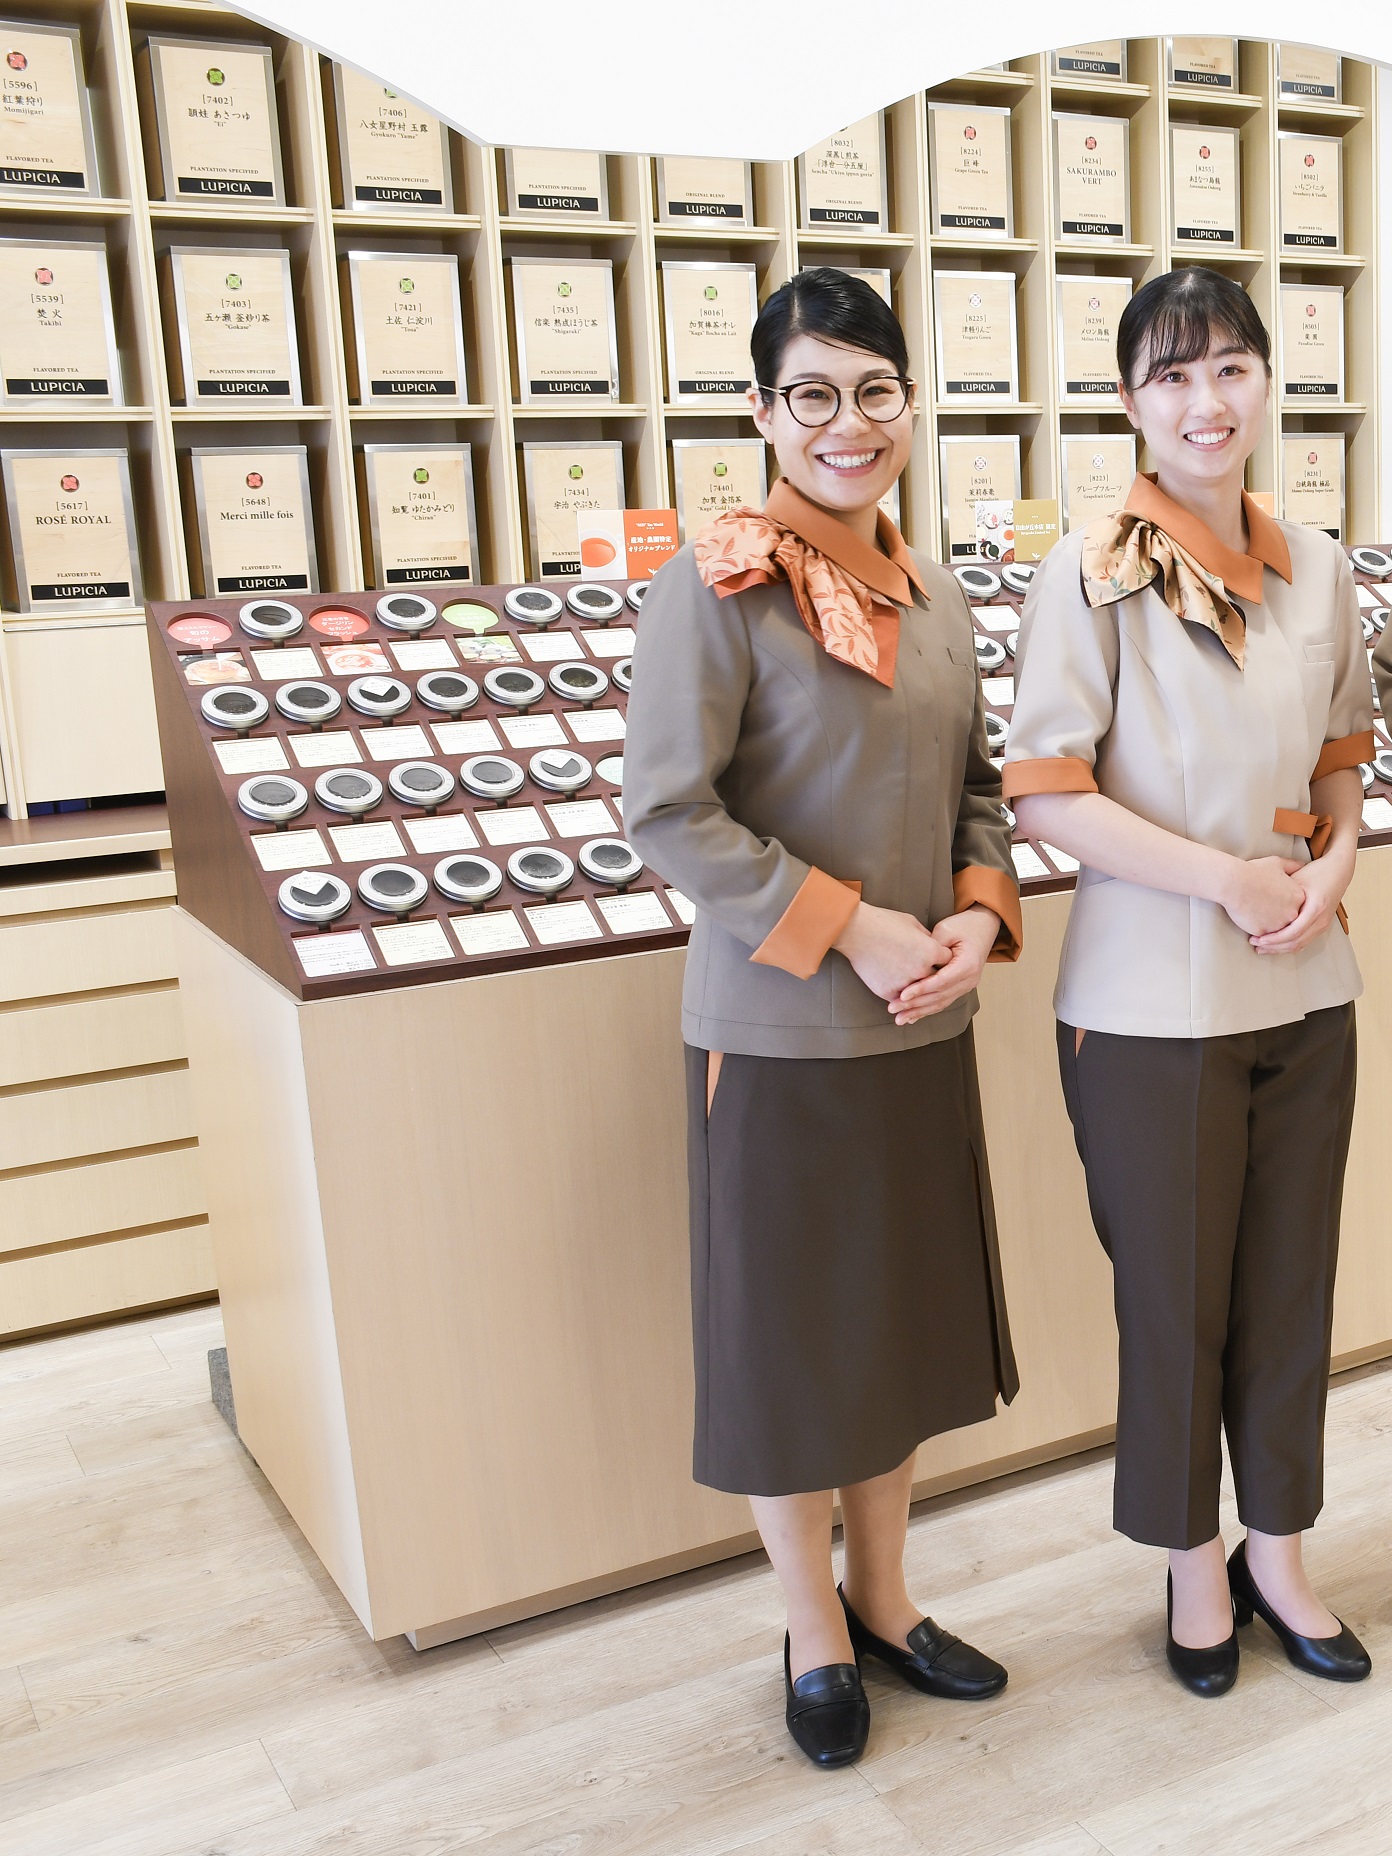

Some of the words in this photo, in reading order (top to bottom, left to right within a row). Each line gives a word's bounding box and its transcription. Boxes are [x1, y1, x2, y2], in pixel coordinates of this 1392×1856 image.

[1073, 62, 1106, 72] LUPICIA
[1188, 74, 1218, 84] LUPICIA
[3, 78, 38, 91] [5596]
[1294, 84, 1322, 94] LUPICIA
[2, 94, 43, 106] 紅葉狩り
[202, 94, 233, 106] [7402]
[4, 106, 44, 116] Momijigari
[213, 109, 250, 121] あさつゆ
[378, 107, 407, 118] [7406]
[360, 120, 406, 132] 八女星野村
[410, 124, 428, 133] 玉露
[831, 138, 853, 148] [8032]
[960, 147, 982, 156] [8224]
[4, 170, 61, 184] LUPICIA
[1066, 167, 1116, 177] SAKURAMBO
[201, 181, 251, 192] LUPICIA
[376, 190, 422, 200] LUPICIA
[538, 198, 580, 208] LUPICIA
[686, 205, 726, 215] LUPICIA
[826, 212, 863, 221] LUPICIA
[956, 218, 990, 226] LUPICIA
[1076, 224, 1110, 234] LUPICIA
[1190, 229, 1222, 240] LUPICIA
[1296, 236, 1325, 245] LUPICIA
[30, 294, 64, 304] [5539]
[221, 299, 251, 308] [7403]
[394, 302, 422, 312] [7421]
[552, 306, 578, 314] [7435]
[700, 308, 724, 318] [8016]
[966, 314, 986, 322] [8225]
[236, 313, 271, 324] 釜炒り茶
[386, 316, 403, 326] 土佐
[534, 318, 550, 328] 信楽
[554, 318, 598, 328] 熟成ほうじ茶
[30, 382, 86, 392] LUPICIA
[219, 383, 270, 394] LUPICIA
[391, 383, 437, 393] LUPICIA
[549, 383, 592, 392] LUPICIA
[696, 383, 735, 392] LUPICIA
[564, 488, 589, 496] [7434]
[710, 484, 733, 492] [7440]
[408, 491, 436, 501] [7401]
[56, 500, 88, 512] [5617]
[242, 496, 270, 507] [5648]
[554, 501, 569, 509] 宇治
[574, 500, 600, 508] やぶきた
[392, 504, 408, 514] 知覧
[412, 504, 455, 514] ゆたかみどり
[36, 514, 68, 526] ROSÉ
[70, 514, 112, 524] ROYAL
[220, 511, 248, 520] Merci
[250, 510, 274, 520] mille
[276, 510, 294, 520] fois
[406, 569, 451, 580] LUPICIA
[239, 578, 288, 589] LUPICIA
[54, 585, 108, 597] LUPICIA
